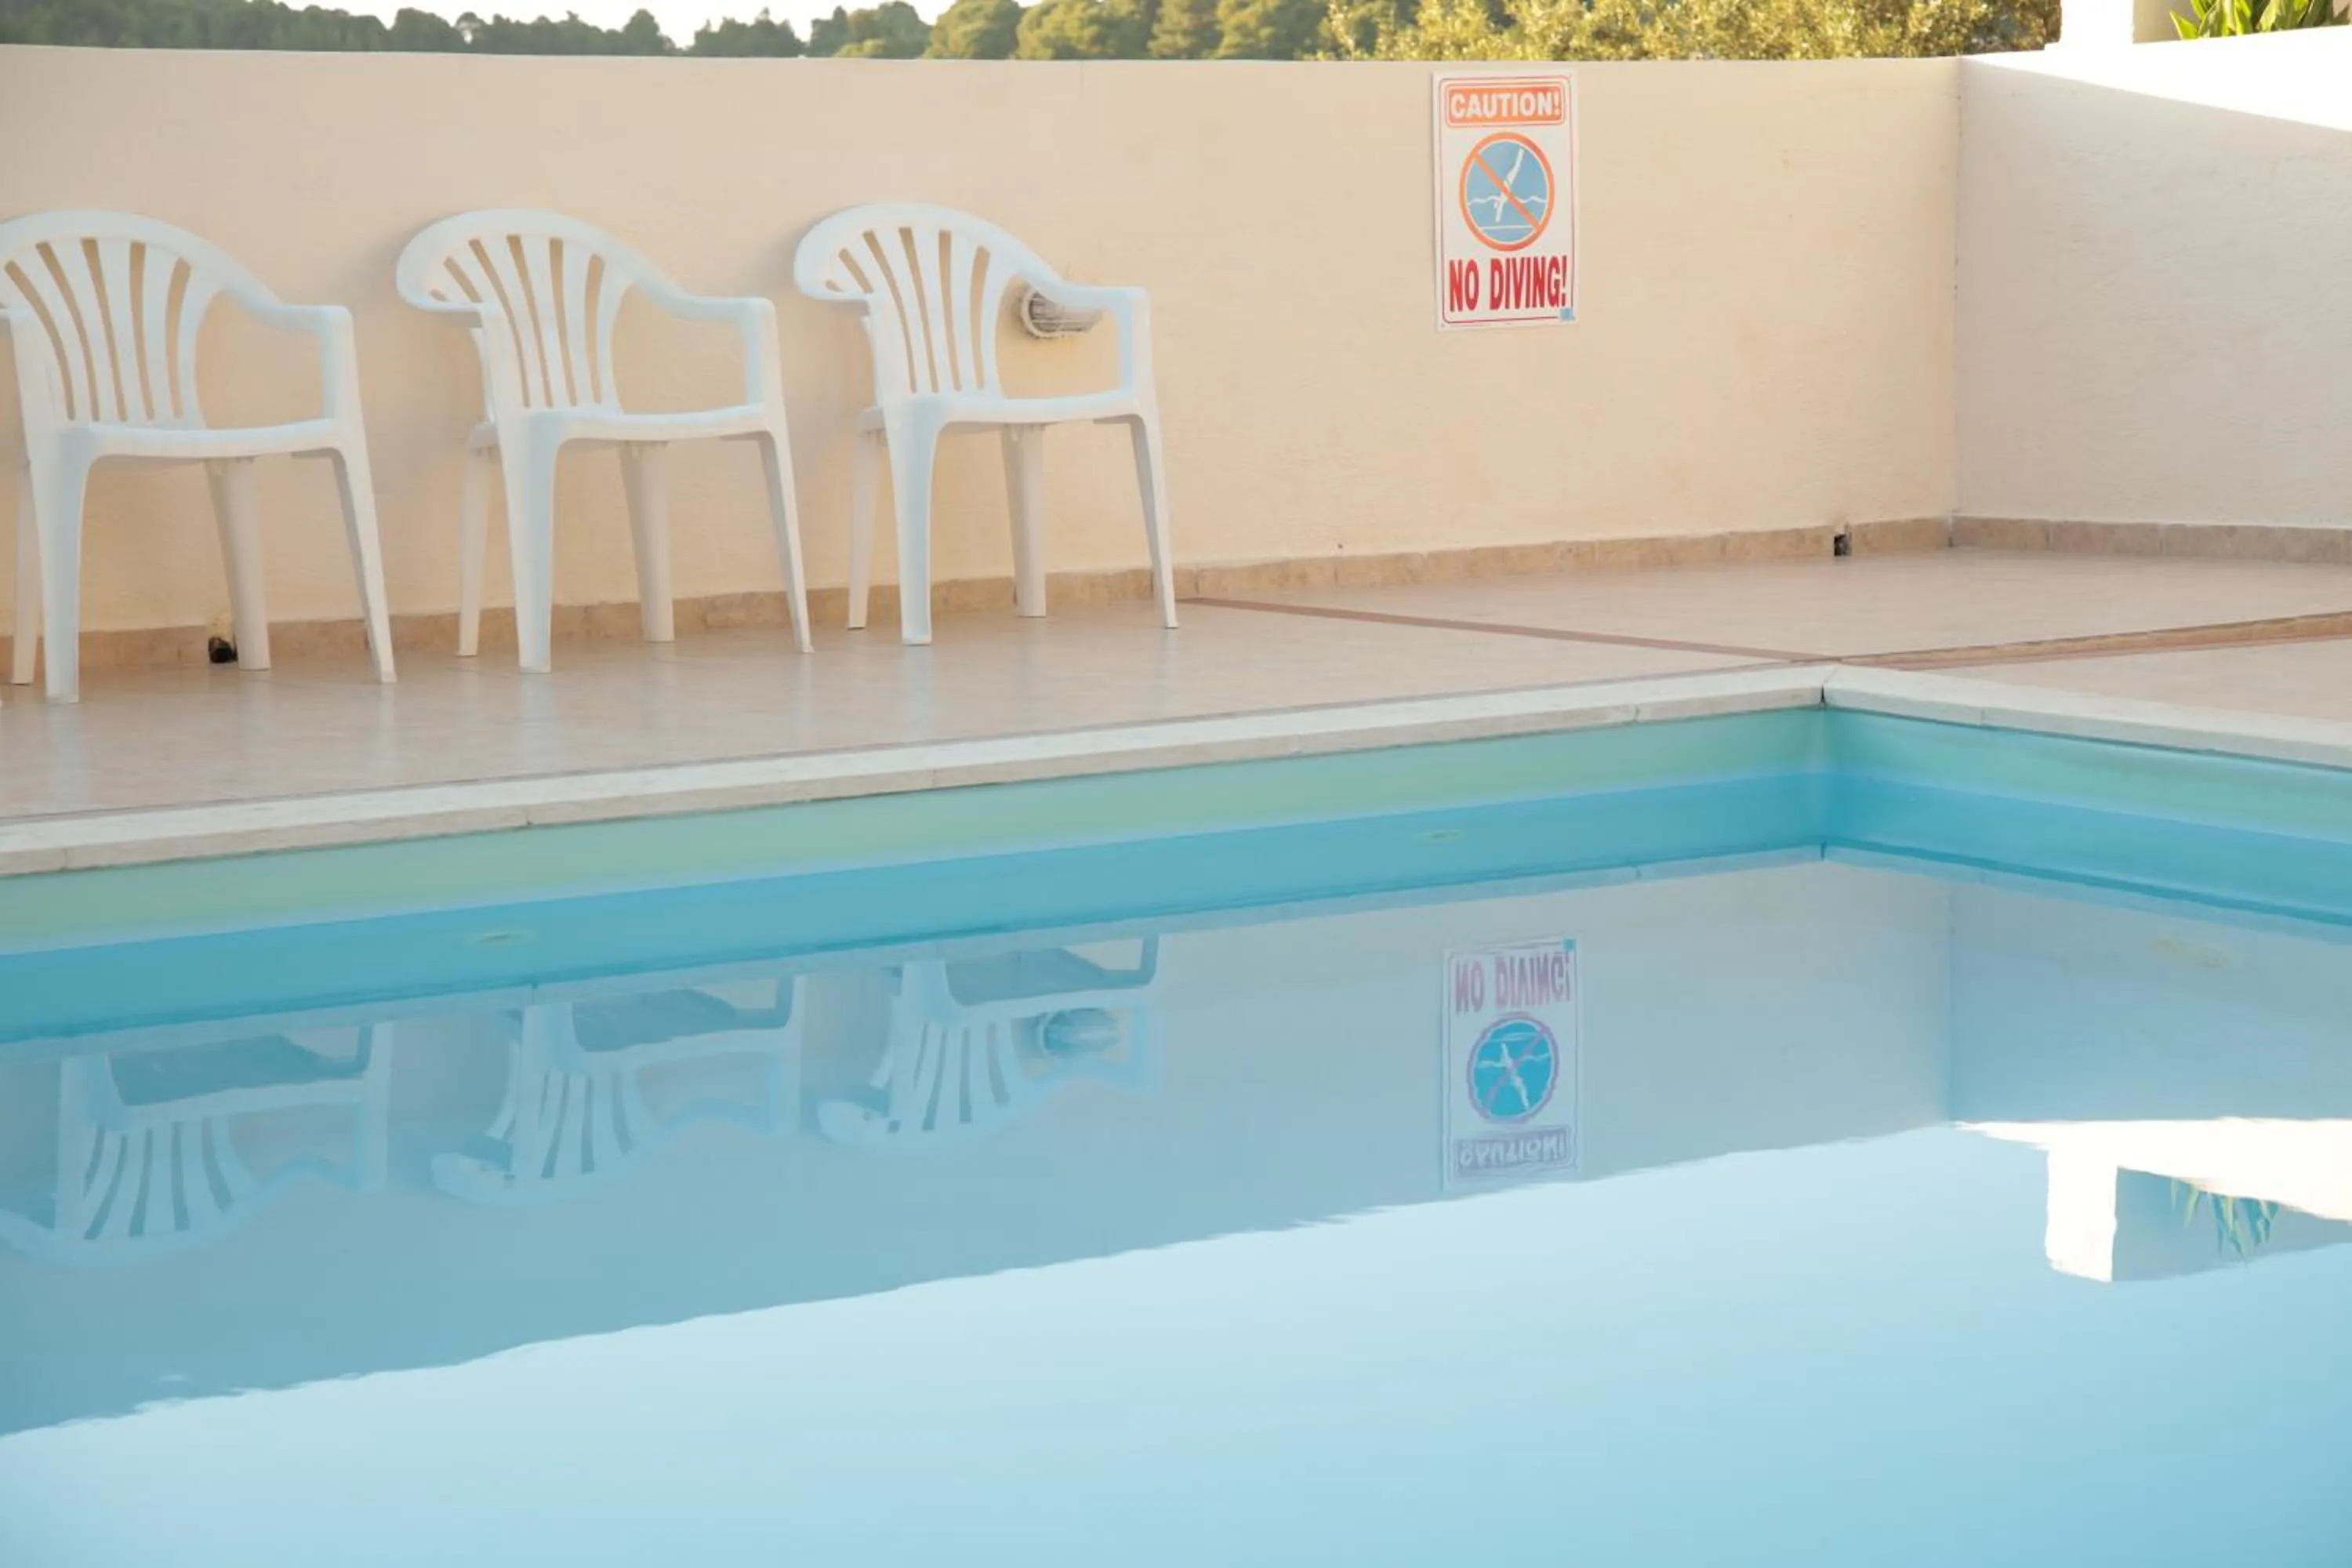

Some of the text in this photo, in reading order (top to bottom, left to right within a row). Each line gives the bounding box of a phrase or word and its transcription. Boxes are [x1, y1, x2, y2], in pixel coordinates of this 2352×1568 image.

[1450, 91, 1562, 119] CAUTION!
[1449, 255, 1568, 312] NO DIVING!
